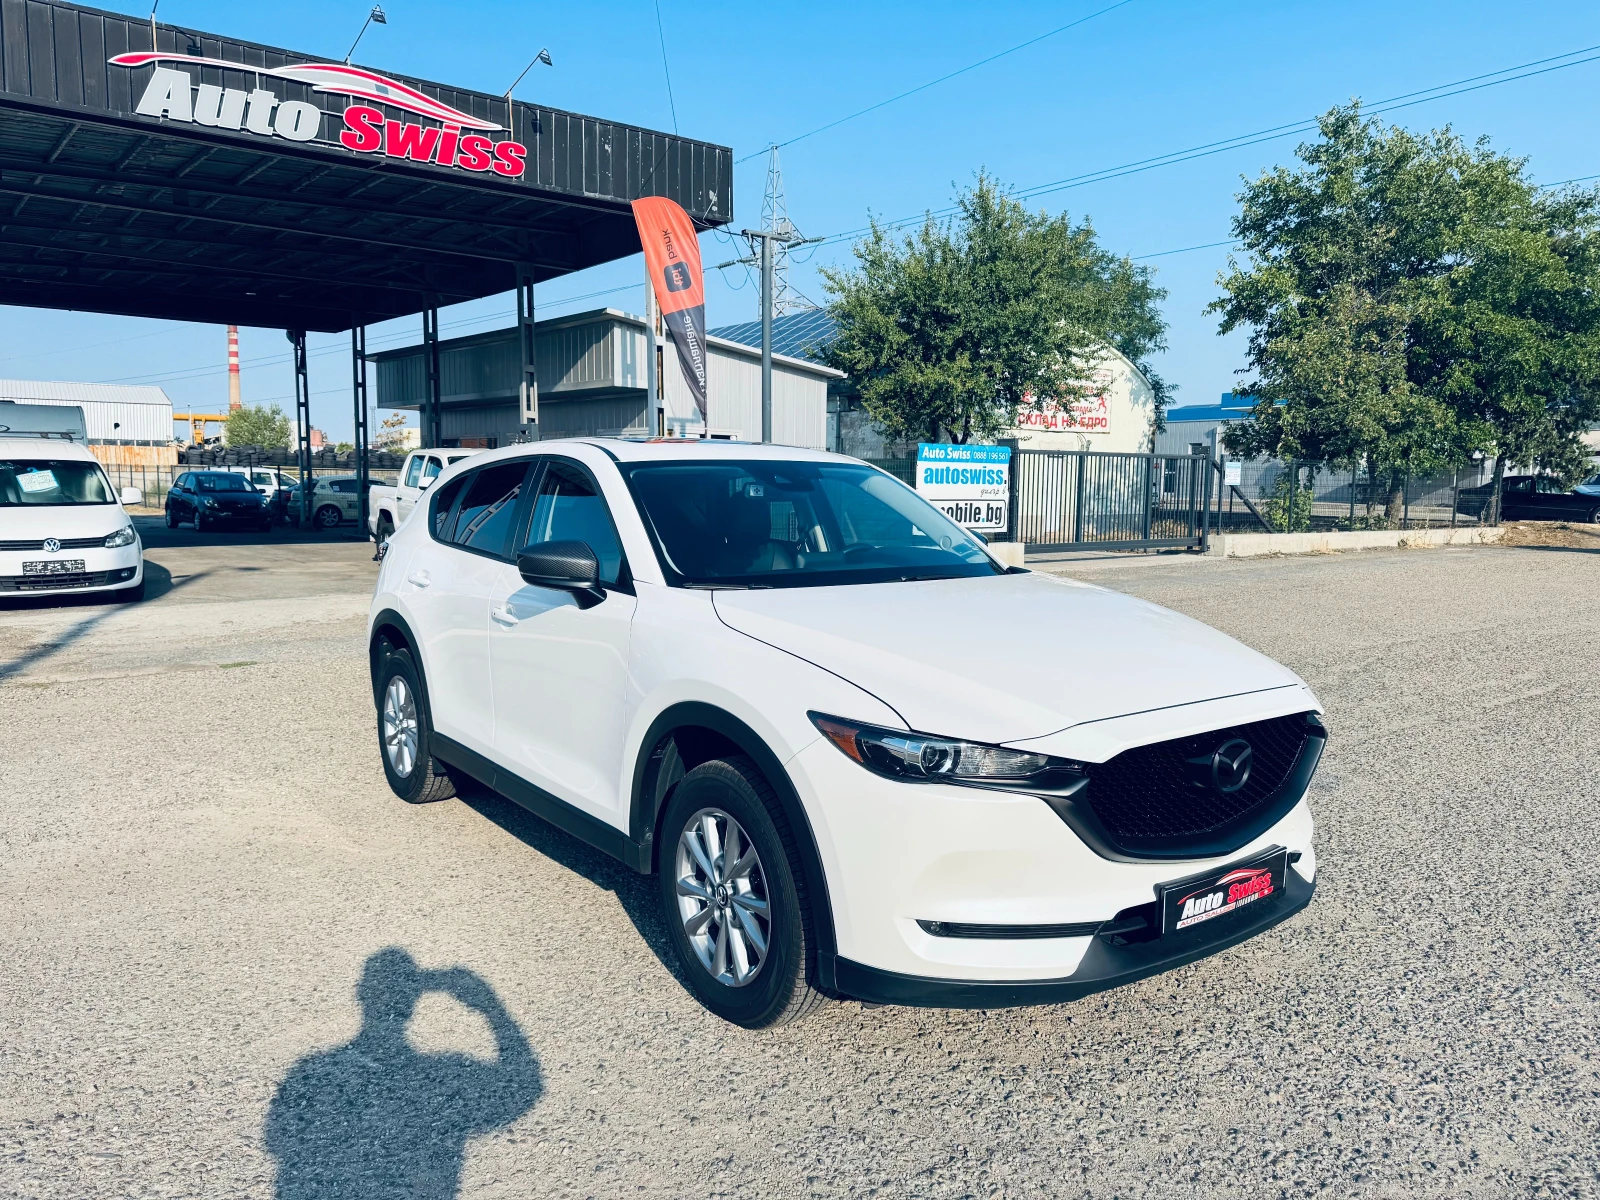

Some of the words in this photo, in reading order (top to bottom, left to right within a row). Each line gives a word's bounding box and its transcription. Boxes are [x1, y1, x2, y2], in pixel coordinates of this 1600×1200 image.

[135, 66, 321, 142] Auto
[339, 105, 528, 177] Swiss
[922, 446, 945, 460] Auto
[946, 447, 971, 460] Swiss
[1180, 891, 1224, 920] Auto
[1226, 872, 1272, 903] Swiss
